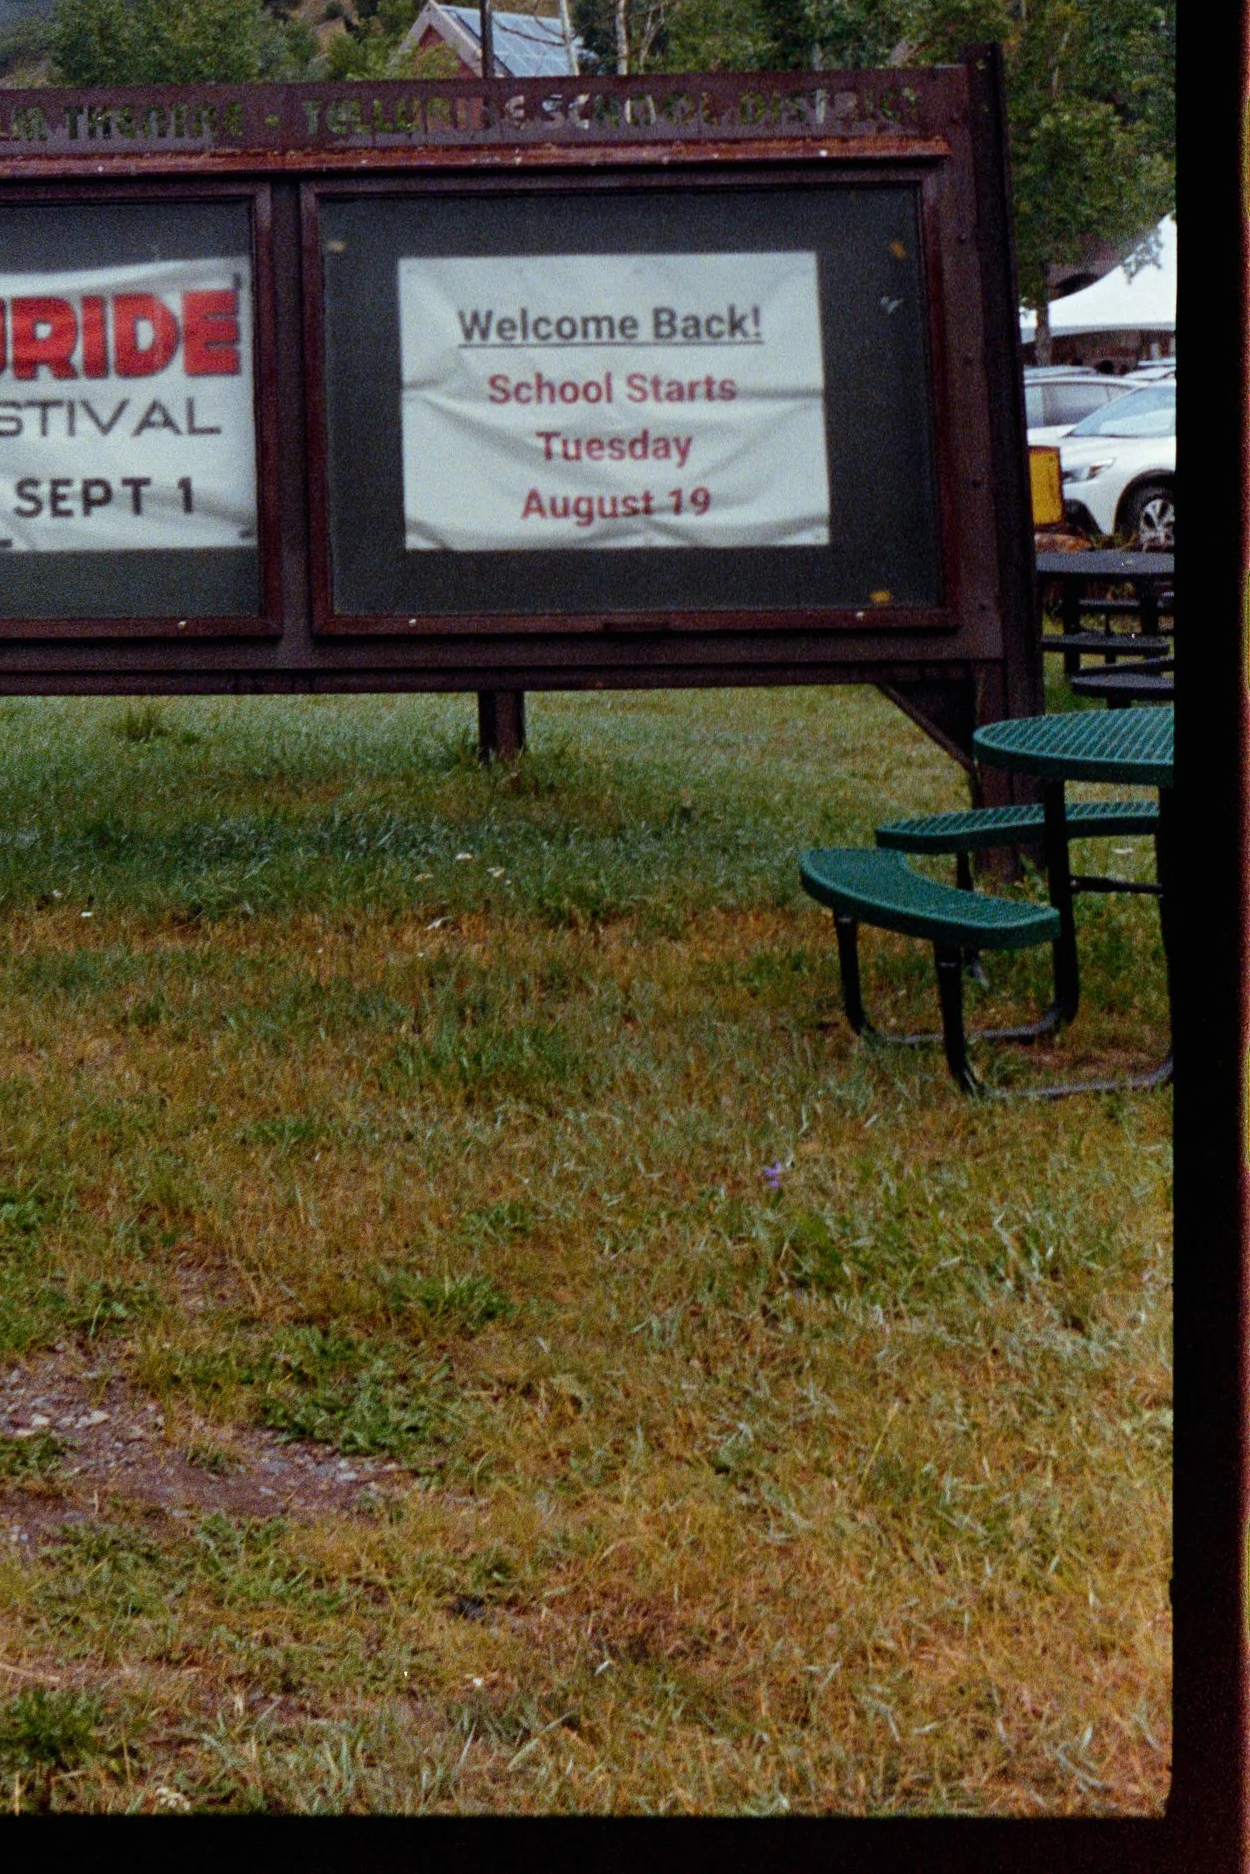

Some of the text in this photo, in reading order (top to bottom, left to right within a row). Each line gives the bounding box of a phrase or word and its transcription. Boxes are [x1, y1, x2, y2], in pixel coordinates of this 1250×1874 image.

[65, 100, 244, 139] THEATRE
[541, 89, 716, 131] SCHOOL
[458, 304, 763, 342] Welcome Back!
[486, 372, 738, 405] School Starts
[535, 428, 694, 469] Tuesday
[12, 474, 151, 519] SEPT
[176, 476, 195, 515] 1
[521, 486, 713, 528] August 19
